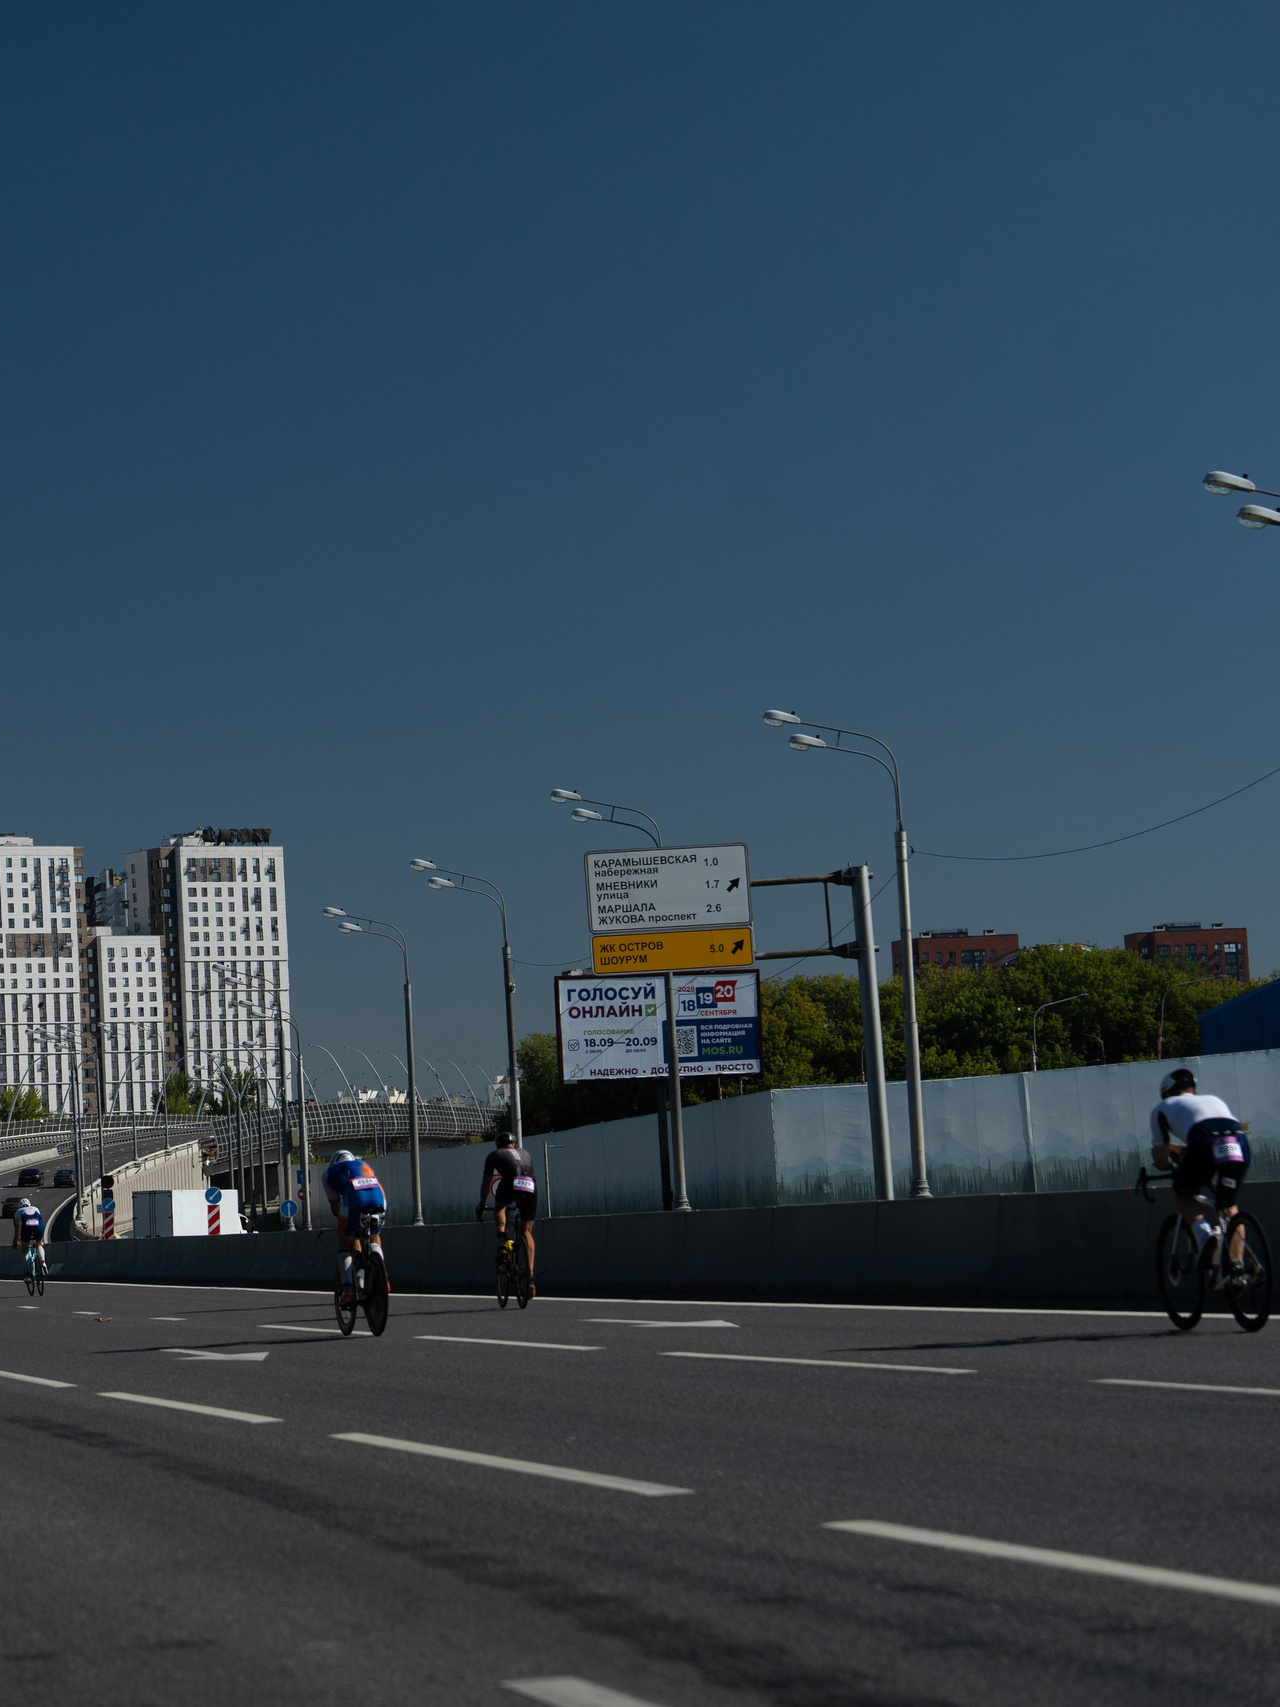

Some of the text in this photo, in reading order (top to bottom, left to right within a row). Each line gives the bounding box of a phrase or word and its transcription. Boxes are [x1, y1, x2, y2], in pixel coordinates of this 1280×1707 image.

[593, 854, 719, 869] КАРАМЫШЕВСКАЯ 1.0
[594, 867, 659, 878] набережная
[596, 879, 720, 892] МНЕВНИКИ 1.7
[596, 891, 629, 902] улица
[597, 902, 722, 914] МАРШАЛА 2.6
[598, 912, 697, 925] ЖУКОВА проспект
[599, 941, 725, 953] ЖК ОСТРОВ 5.0
[600, 954, 648, 966] ШОУРУМ
[566, 982, 656, 1002] ГОЛОСУЙ
[680, 985, 734, 1012] 18 19 20
[568, 1001, 643, 1019] ОНЛАЙН
[699, 1009, 737, 1017] СЕНТЯБРЯ
[583, 1028, 635, 1036] ГОЛОСОВАНИЕ
[701, 1045, 744, 1056] MOS.RU
[589, 1062, 755, 1077] НАДЕЖНО ДОСУПНО ПРОСТО
